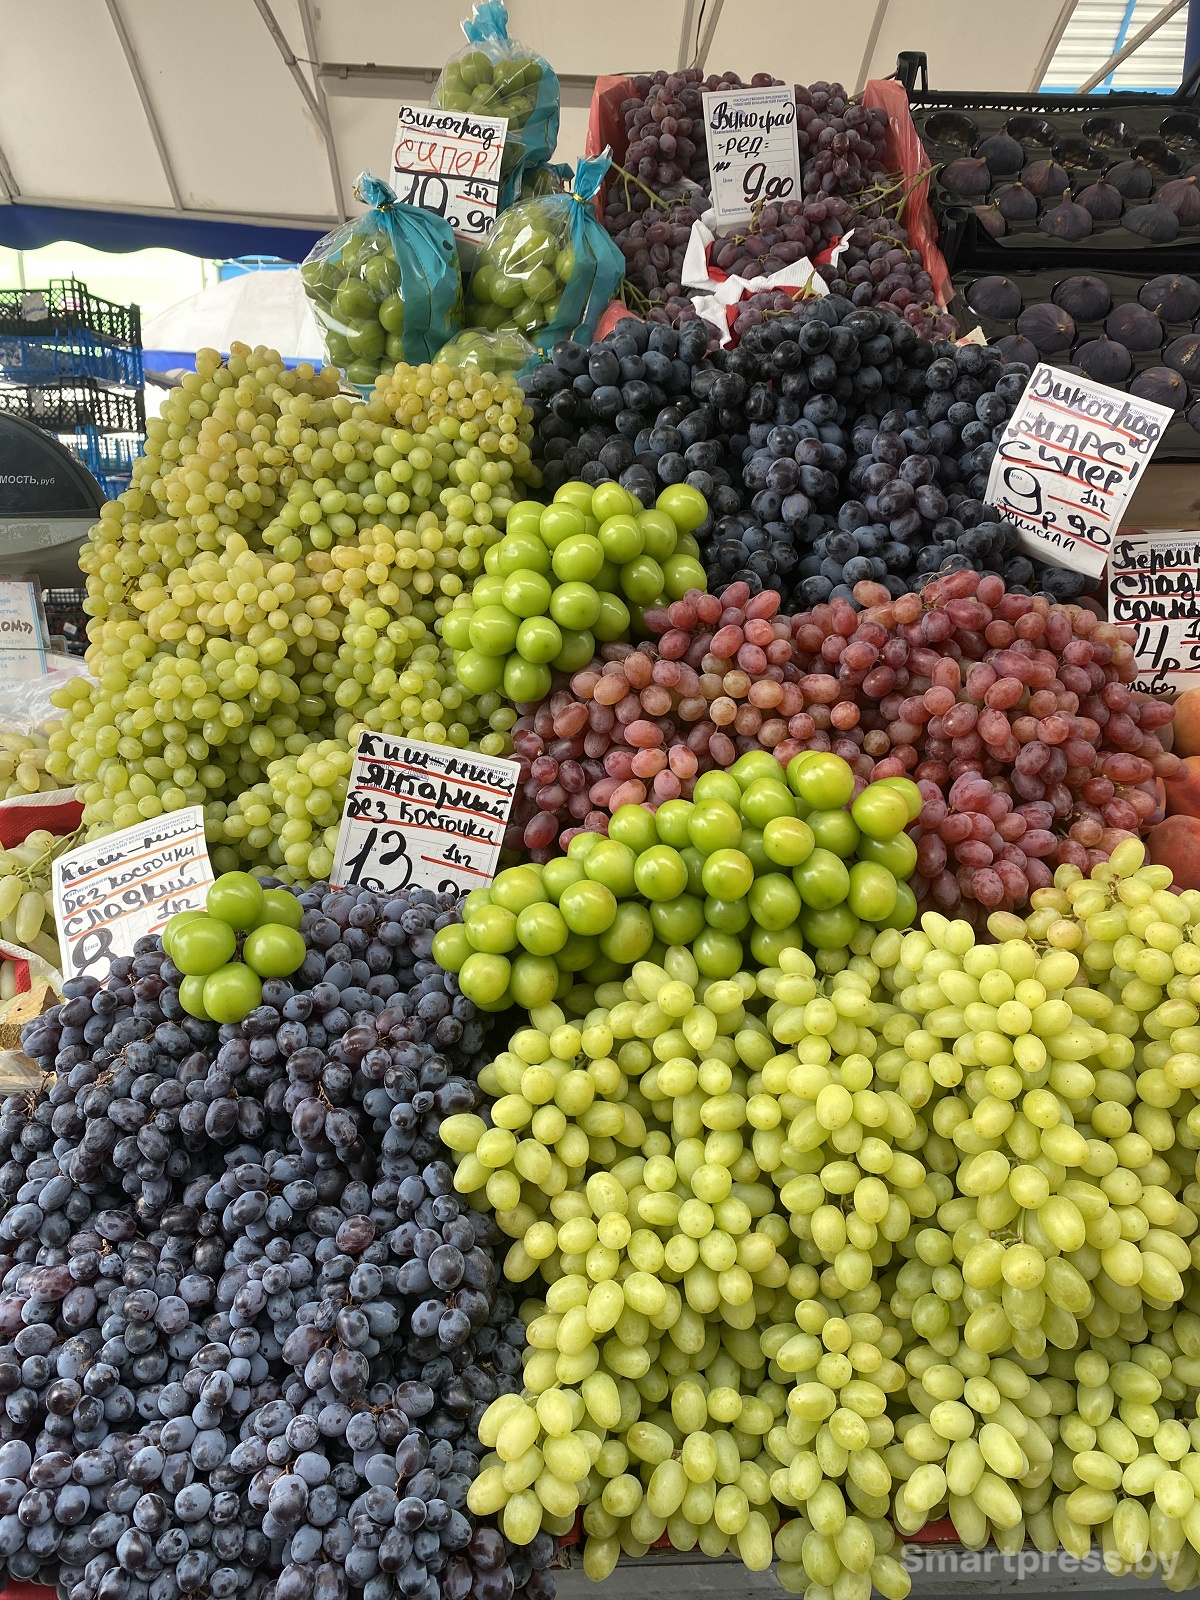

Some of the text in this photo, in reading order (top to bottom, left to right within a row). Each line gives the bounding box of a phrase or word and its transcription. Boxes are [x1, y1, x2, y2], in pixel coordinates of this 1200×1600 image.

[399, 106, 500, 150] Виноград
[709, 101, 796, 135] Виноград
[1029, 367, 1161, 453] Виноград
